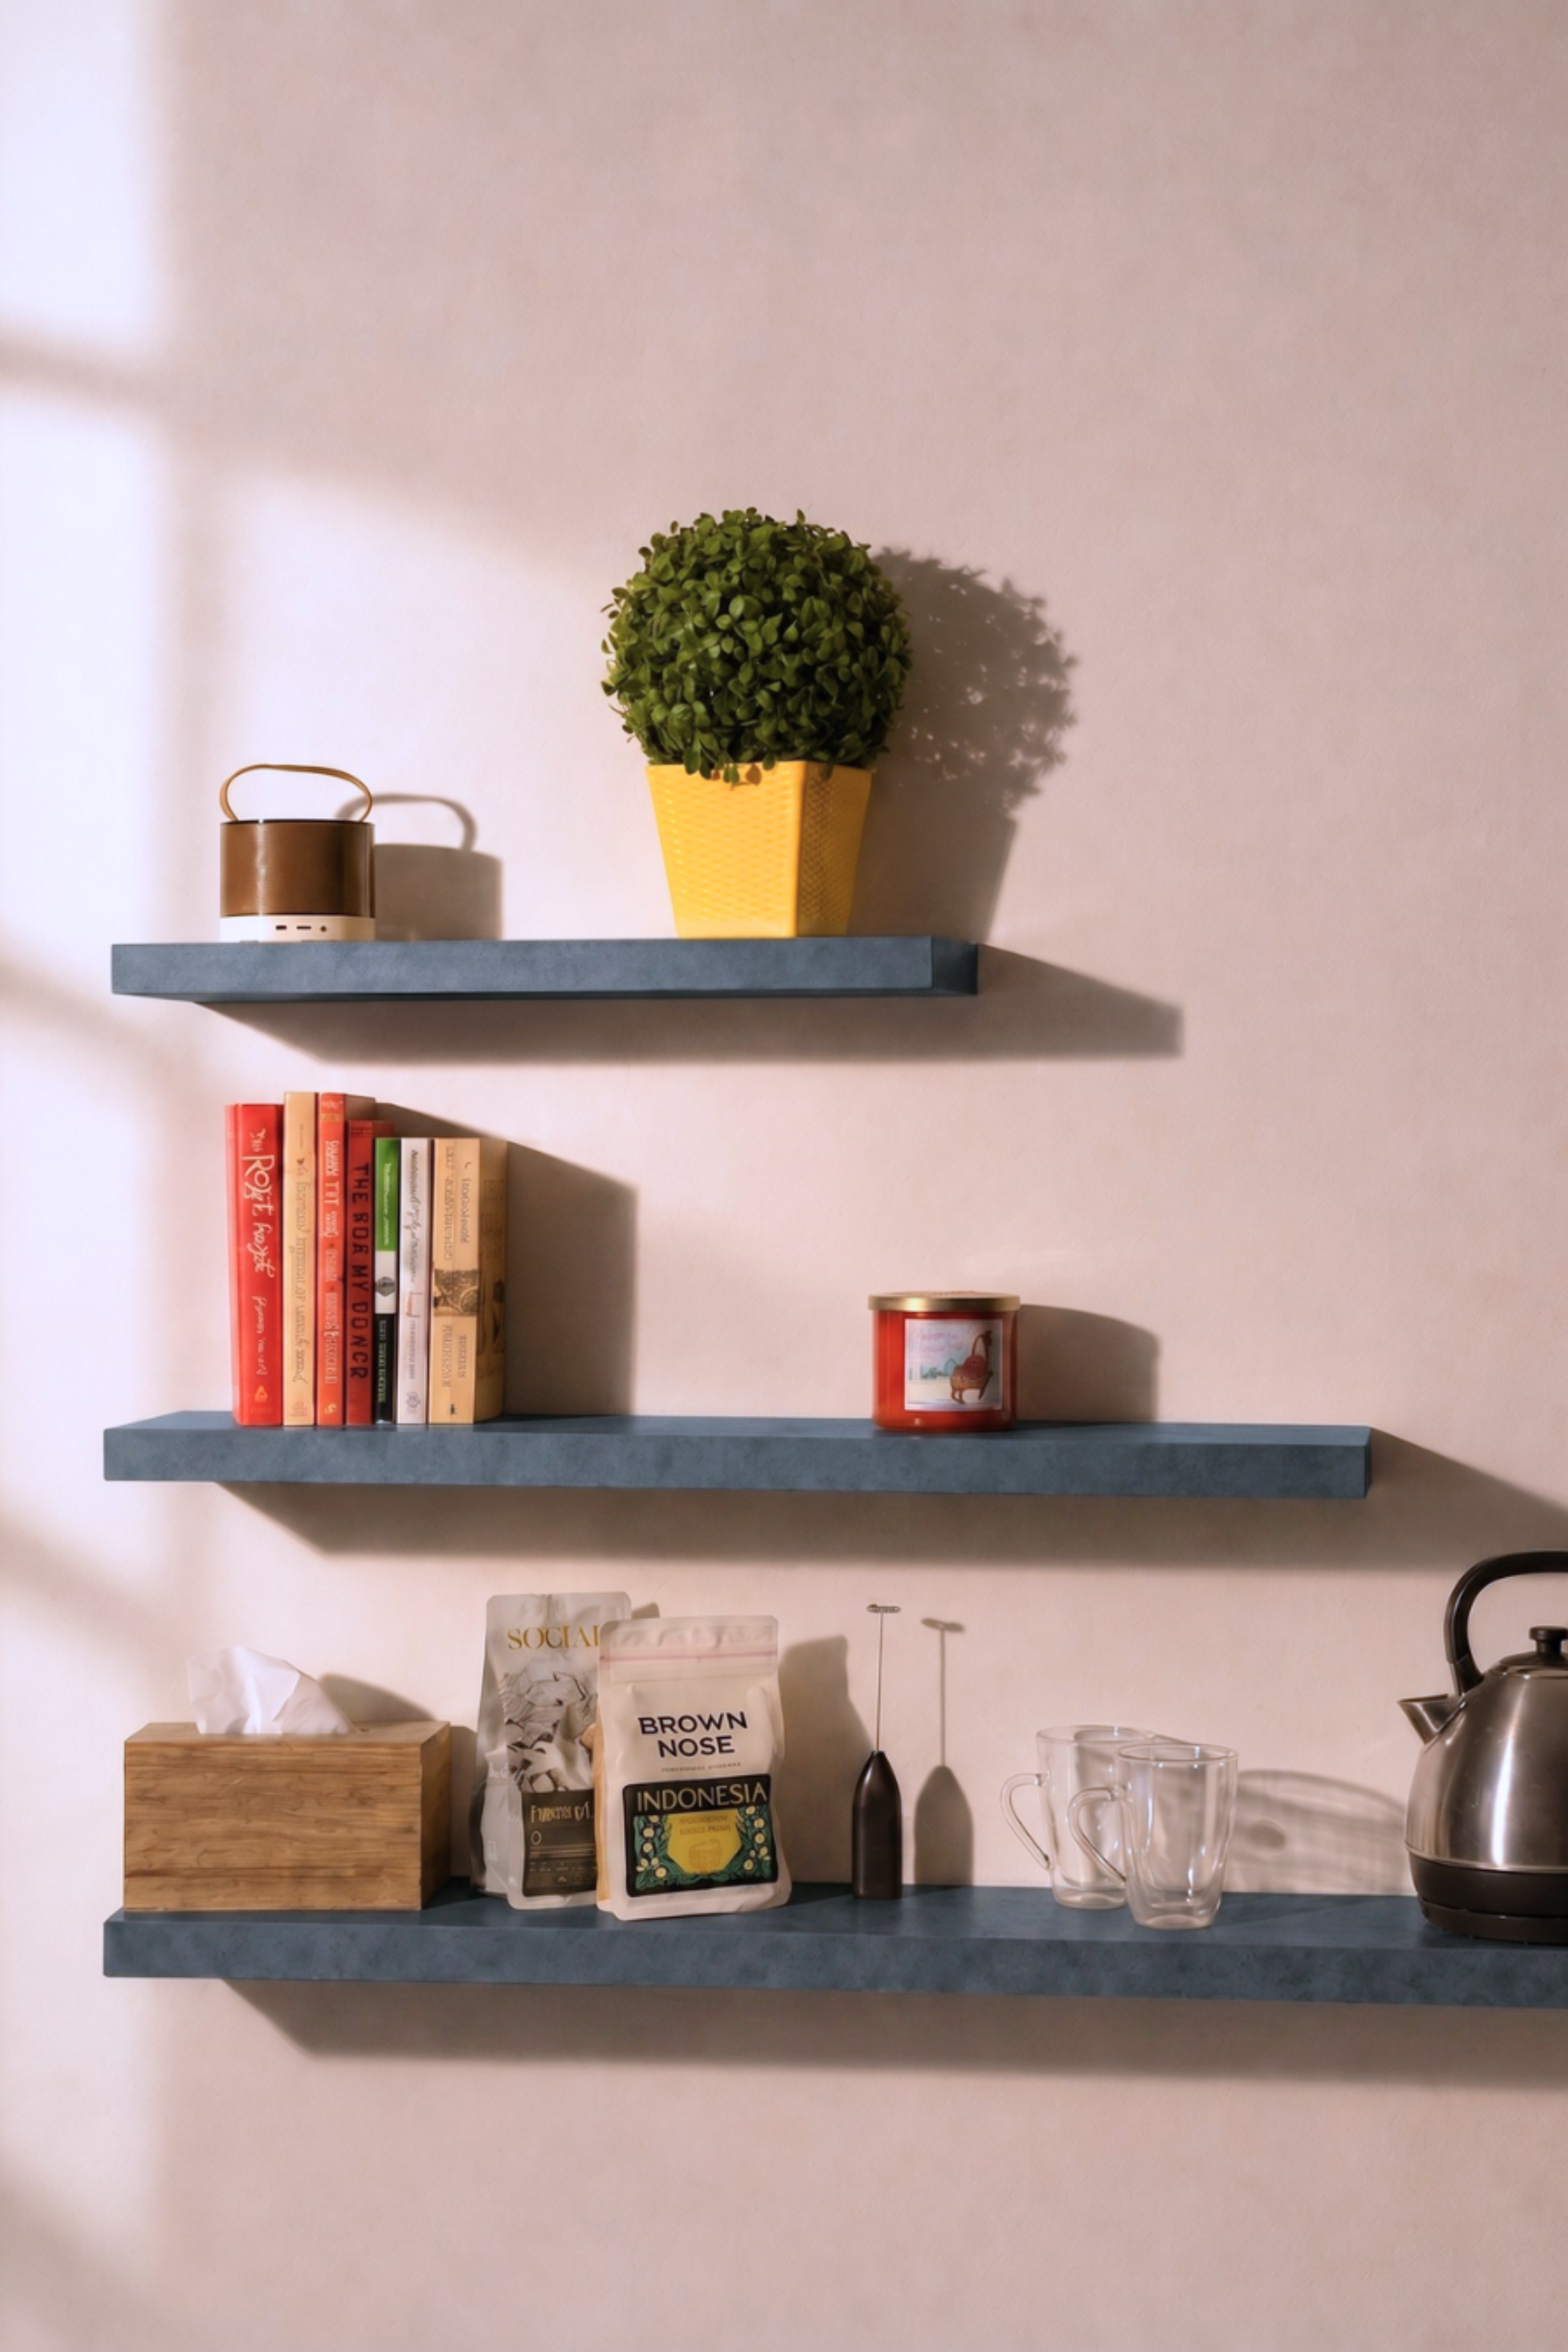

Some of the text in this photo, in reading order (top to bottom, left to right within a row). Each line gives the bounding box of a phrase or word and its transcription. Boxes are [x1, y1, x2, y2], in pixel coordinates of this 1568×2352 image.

[352, 1162, 370, 1204] THE
[351, 1264, 369, 1292] MY
[638, 1711, 748, 1735] BROWN
[657, 1735, 735, 1758] NOSE
[637, 1781, 767, 1812] INDONESIA
